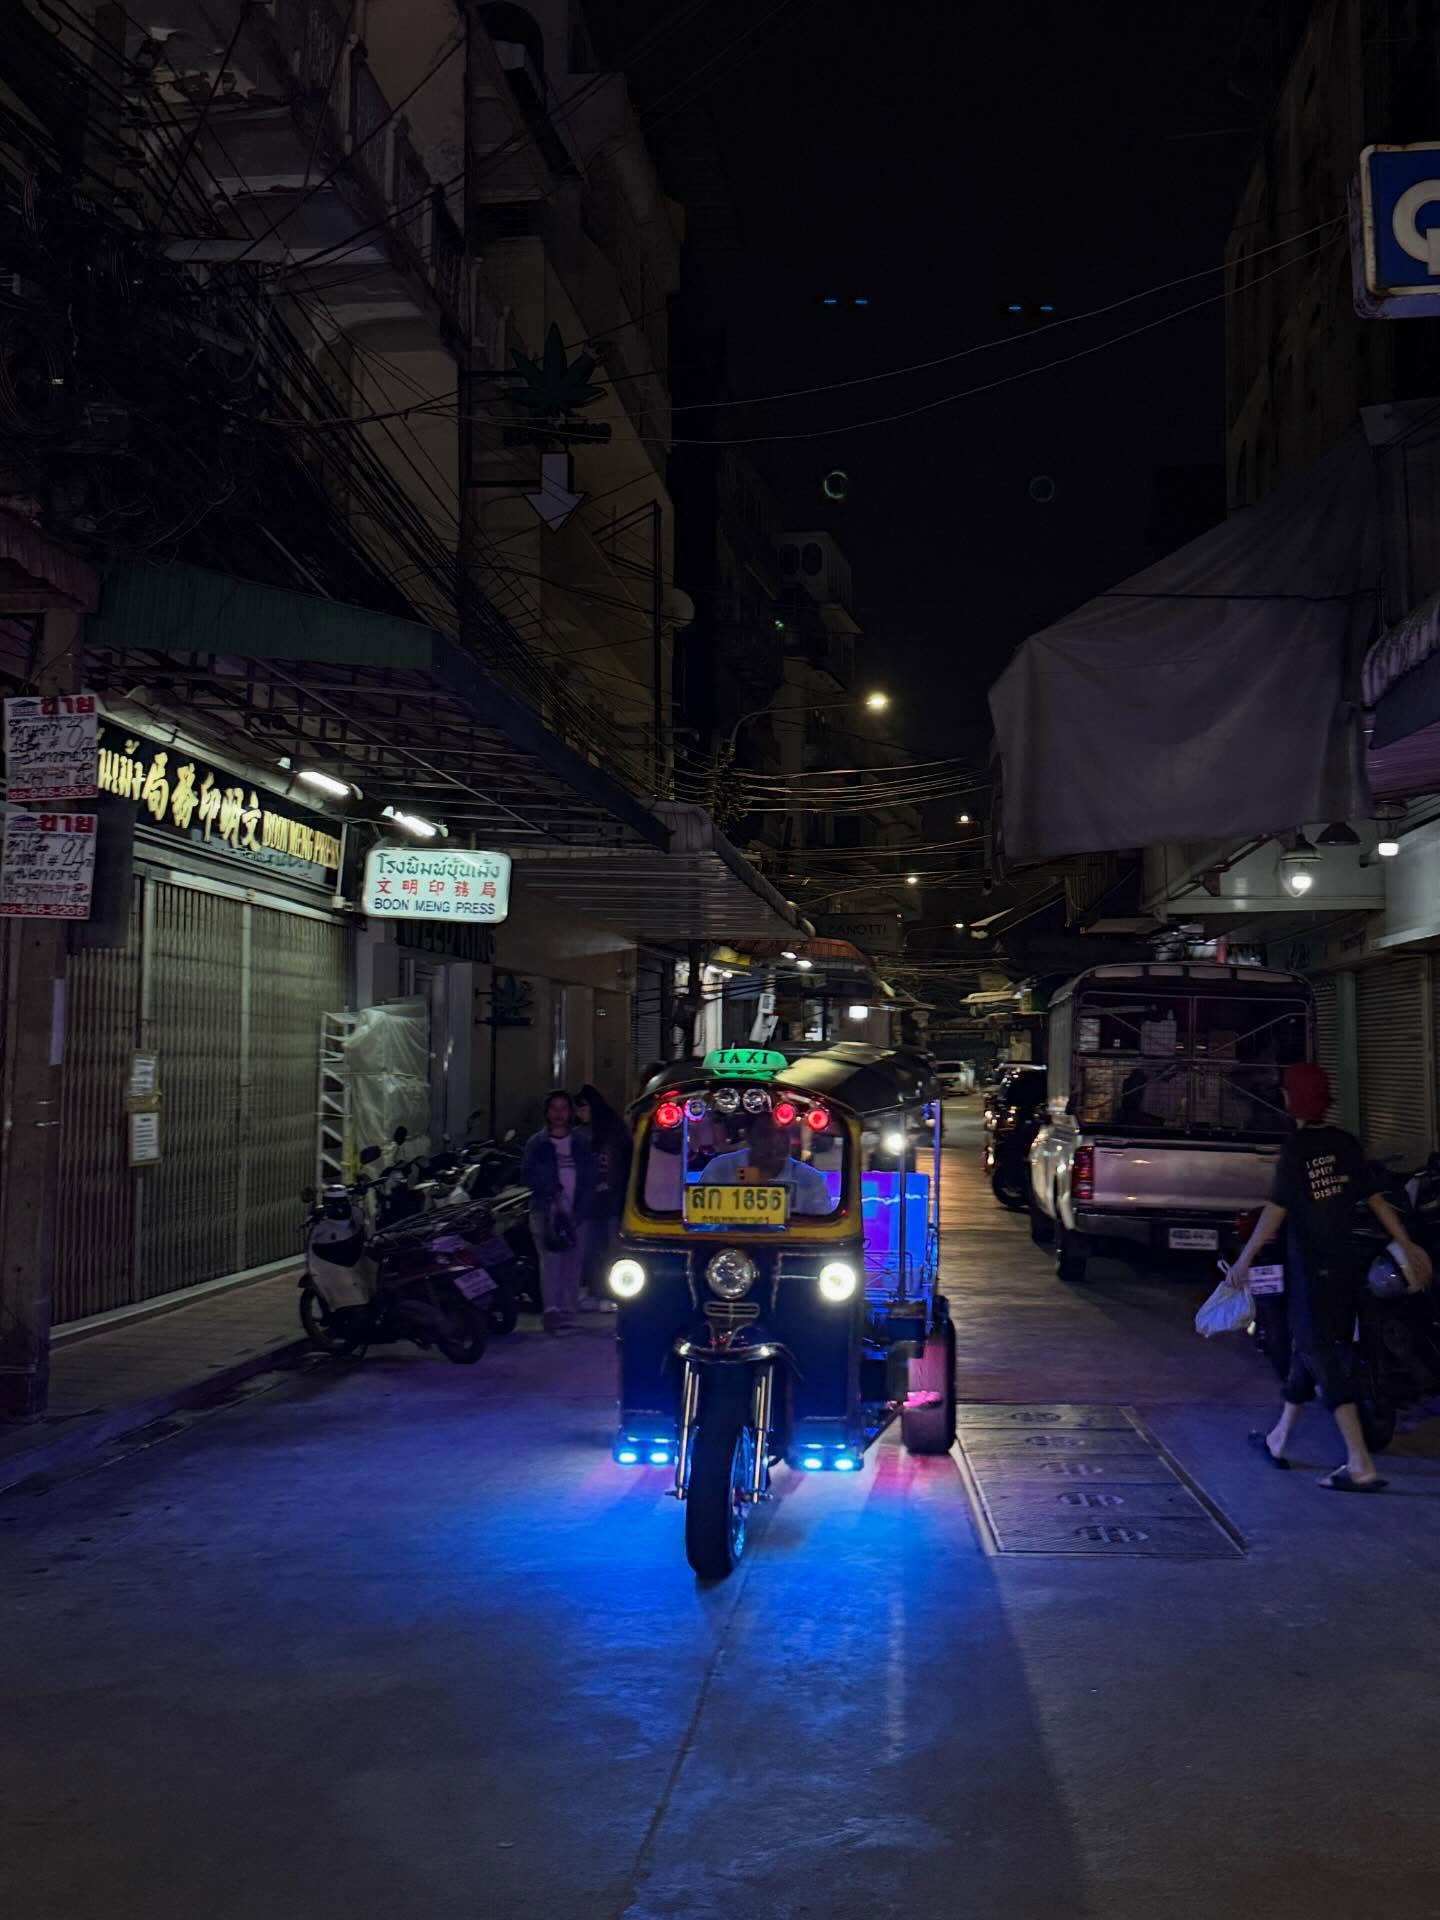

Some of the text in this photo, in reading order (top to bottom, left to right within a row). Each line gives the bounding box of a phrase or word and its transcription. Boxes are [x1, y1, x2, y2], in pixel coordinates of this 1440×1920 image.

[40, 697, 95, 715] ขาย
[39, 814, 93, 833] ขาย
[374, 898, 496, 915] BOON MENG PRESS
[718, 1051, 768, 1064] TAXI
[732, 1188, 782, 1211] 1856
